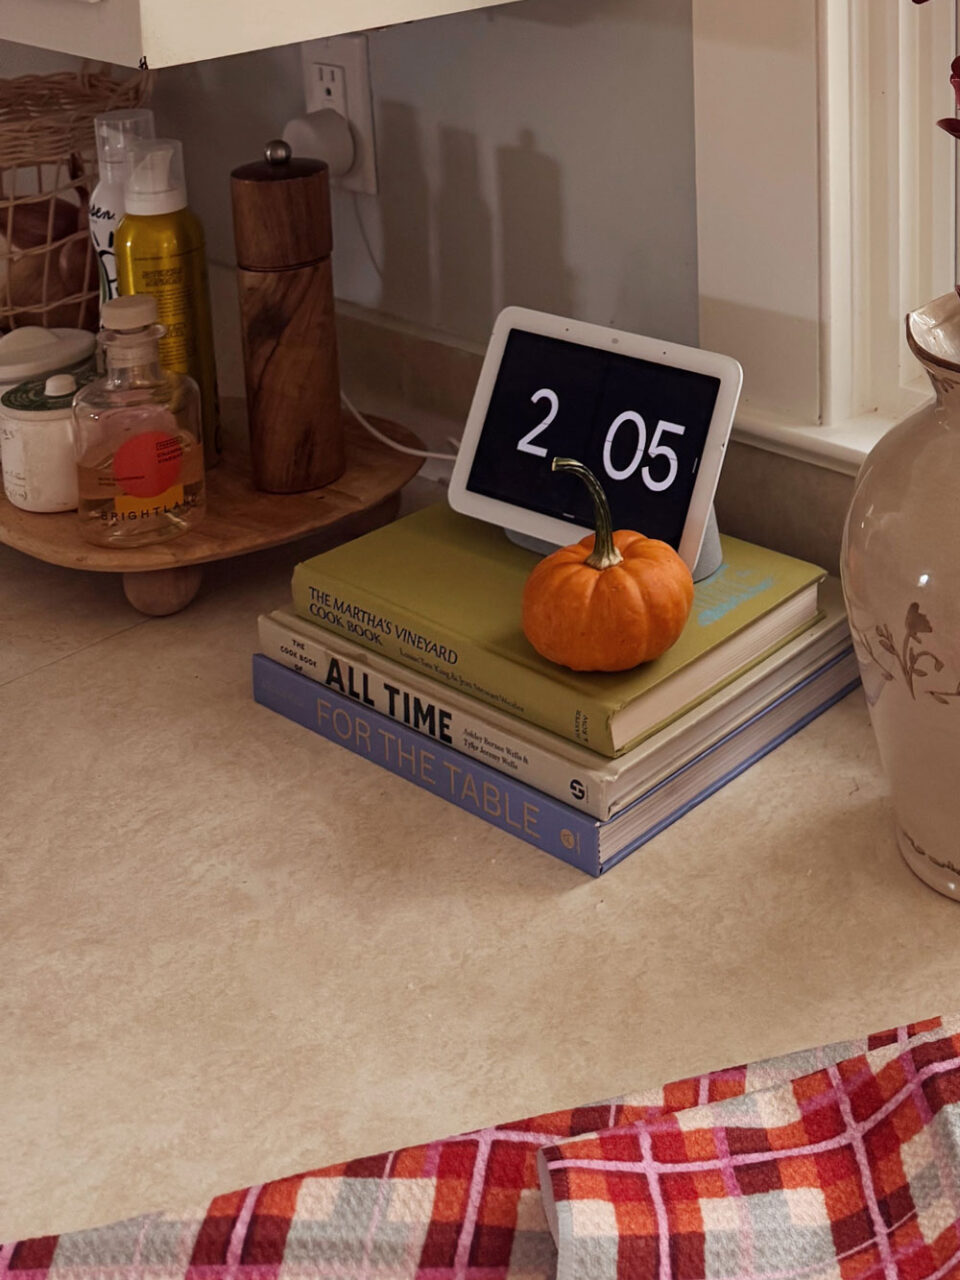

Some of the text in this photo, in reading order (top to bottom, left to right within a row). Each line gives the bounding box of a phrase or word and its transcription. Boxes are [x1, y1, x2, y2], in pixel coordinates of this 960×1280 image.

[516, 388, 685, 492] 2 05
[292, 639, 305, 651] THE
[298, 654, 317, 668] BOOK
[308, 586, 458, 665] THE MARTHA'S VINEYARD
[309, 603, 383, 647] COOK BOOK
[325, 657, 375, 707] ALL
[384, 683, 453, 744] TIME
[317, 698, 541, 839] FOR THE TABLE
